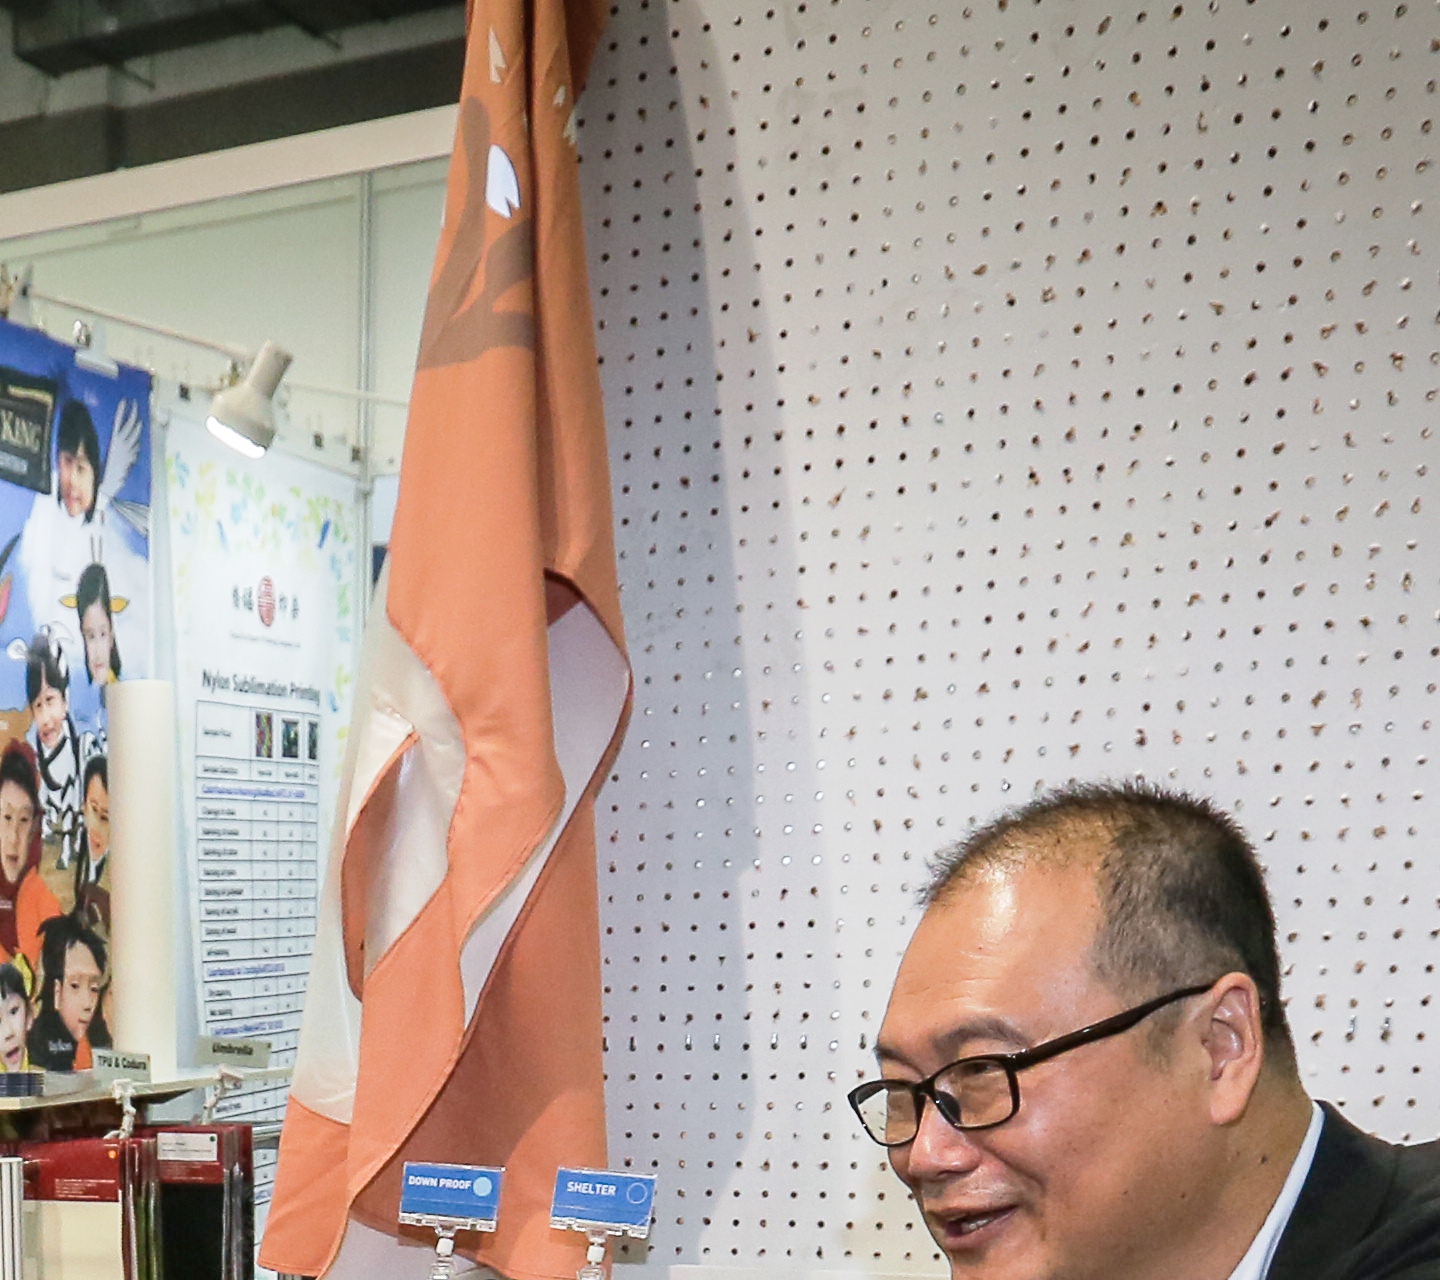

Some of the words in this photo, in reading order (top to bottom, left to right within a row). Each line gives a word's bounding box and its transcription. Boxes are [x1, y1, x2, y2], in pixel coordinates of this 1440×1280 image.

[0, 408, 43, 454] KING
[408, 1174, 437, 1189] DOWN
[438, 1176, 472, 1192] PROOF
[566, 1180, 617, 1197] SHELTER
